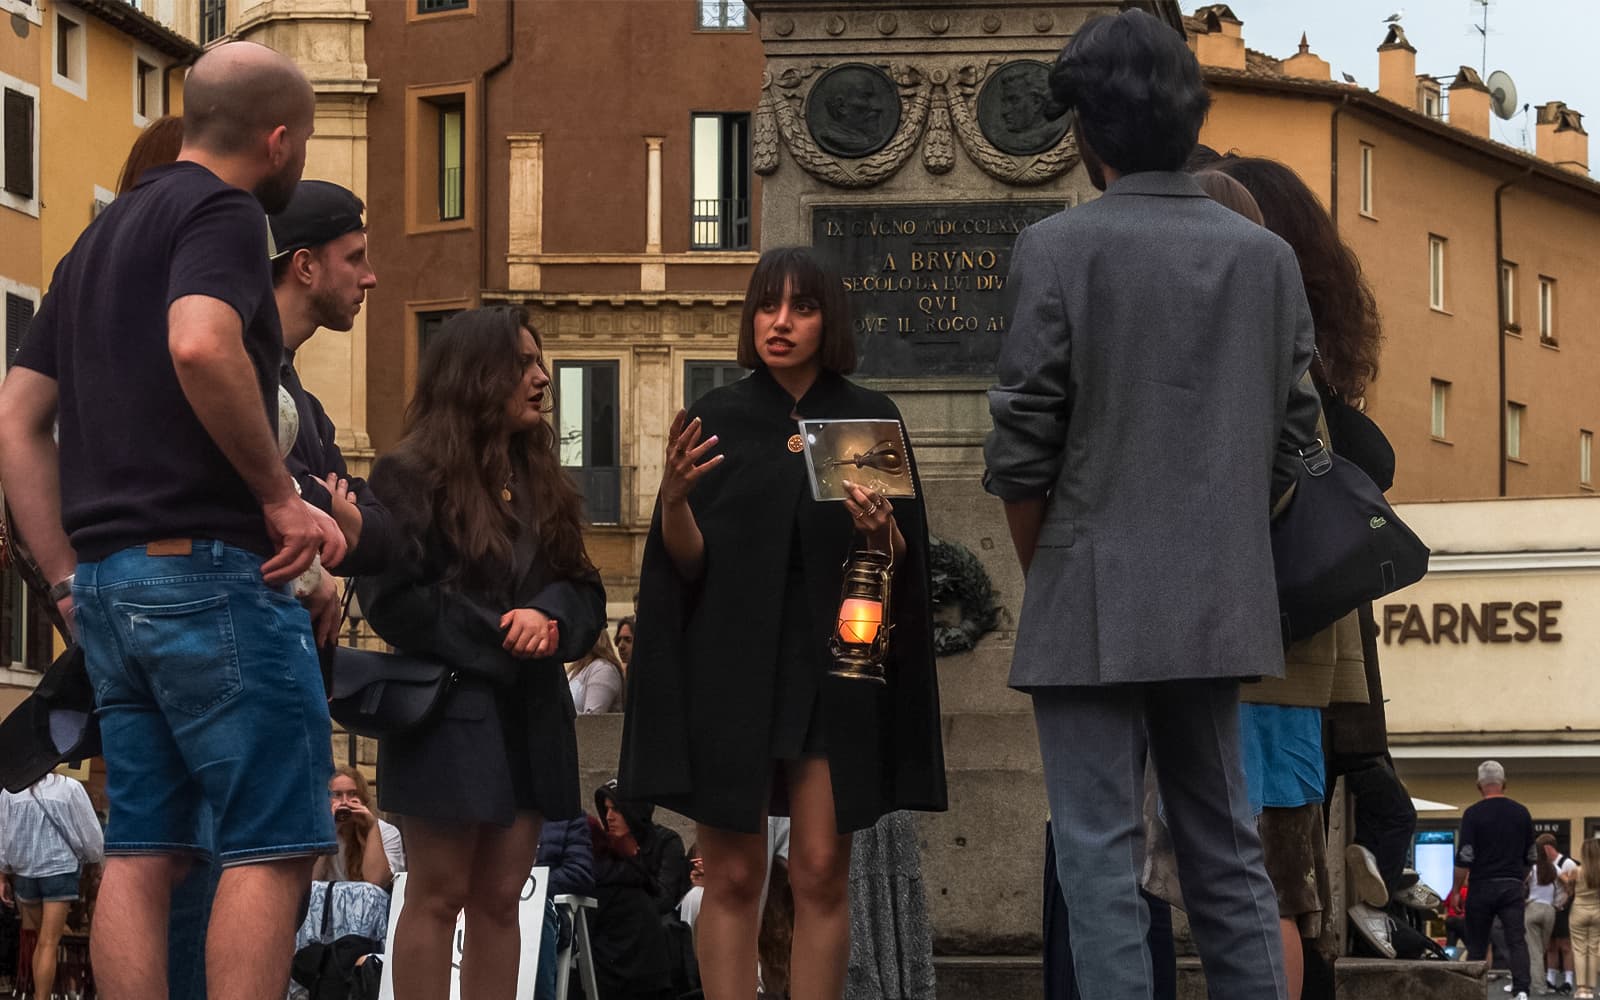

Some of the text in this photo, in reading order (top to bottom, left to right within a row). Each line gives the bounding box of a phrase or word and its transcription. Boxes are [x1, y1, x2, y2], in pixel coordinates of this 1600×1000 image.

[826, 220, 843, 236] IX
[883, 249, 996, 271] A BRVNO
[842, 276, 912, 292] SECOLO
[919, 296, 956, 313] QVI
[926, 316, 978, 332] ROGO
[1383, 601, 1563, 645] FARNESE
